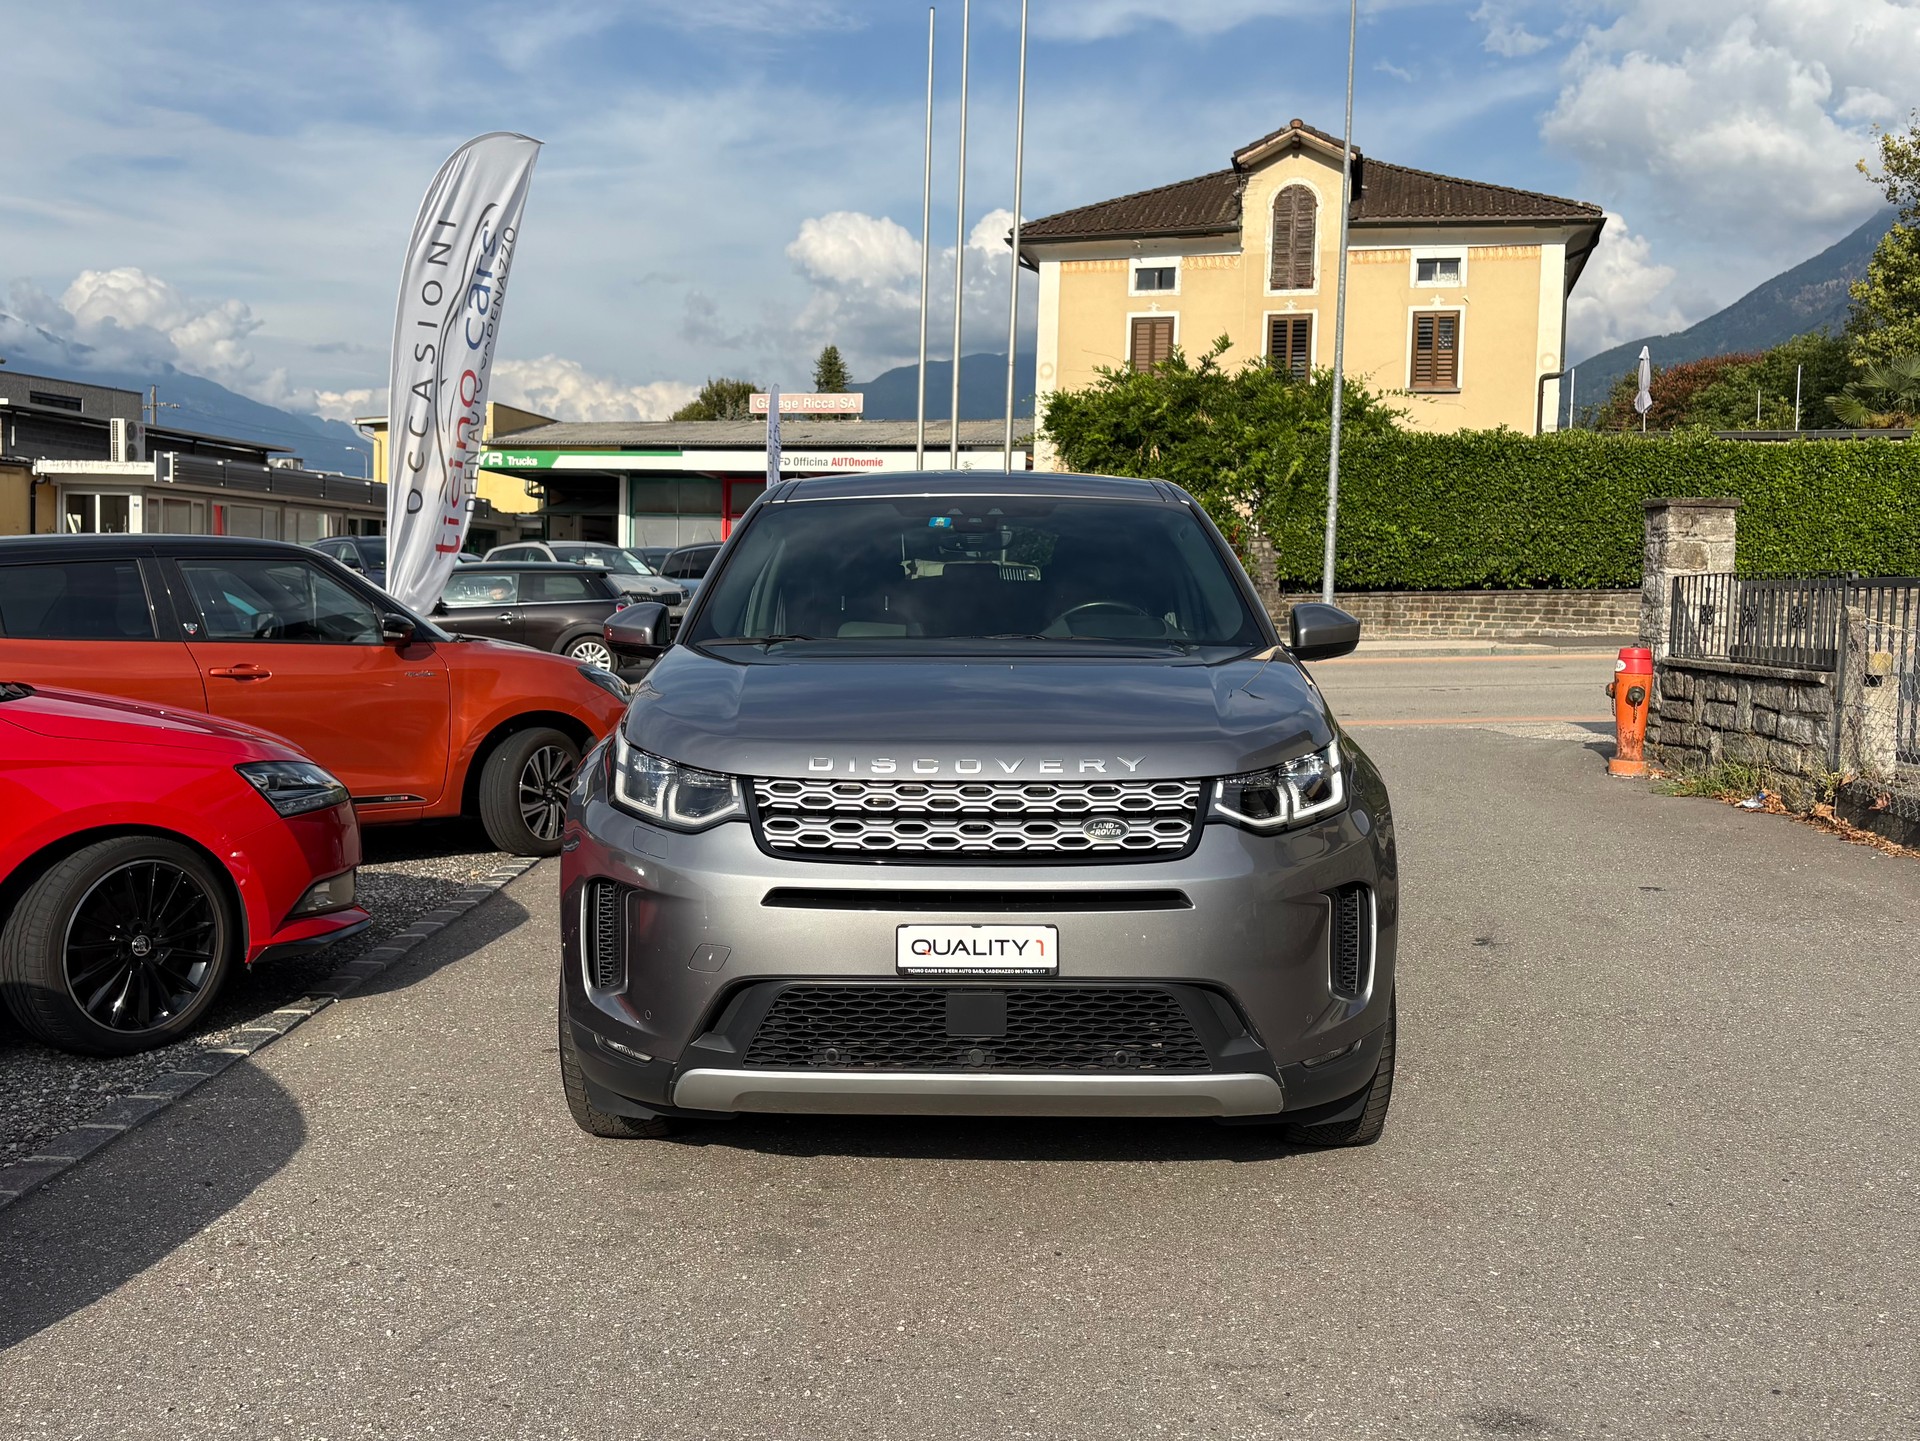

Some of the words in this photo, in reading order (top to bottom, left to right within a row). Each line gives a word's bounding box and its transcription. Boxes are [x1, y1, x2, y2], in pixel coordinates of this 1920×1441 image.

[406, 219, 457, 515] OCCASIONI
[756, 397, 799, 411] Gage
[803, 397, 834, 409] Ricca
[839, 397, 857, 409] SA
[435, 368, 477, 560] ticino
[479, 452, 503, 466] YR
[506, 455, 538, 467] Trucks
[793, 457, 829, 467] Officina
[831, 457, 884, 467] AUTOnomie
[808, 755, 1147, 774] DISCOVERY
[1094, 828, 1122, 836] ROVER
[911, 939, 1030, 956] QUALITY
[1035, 939, 1045, 957] 1
